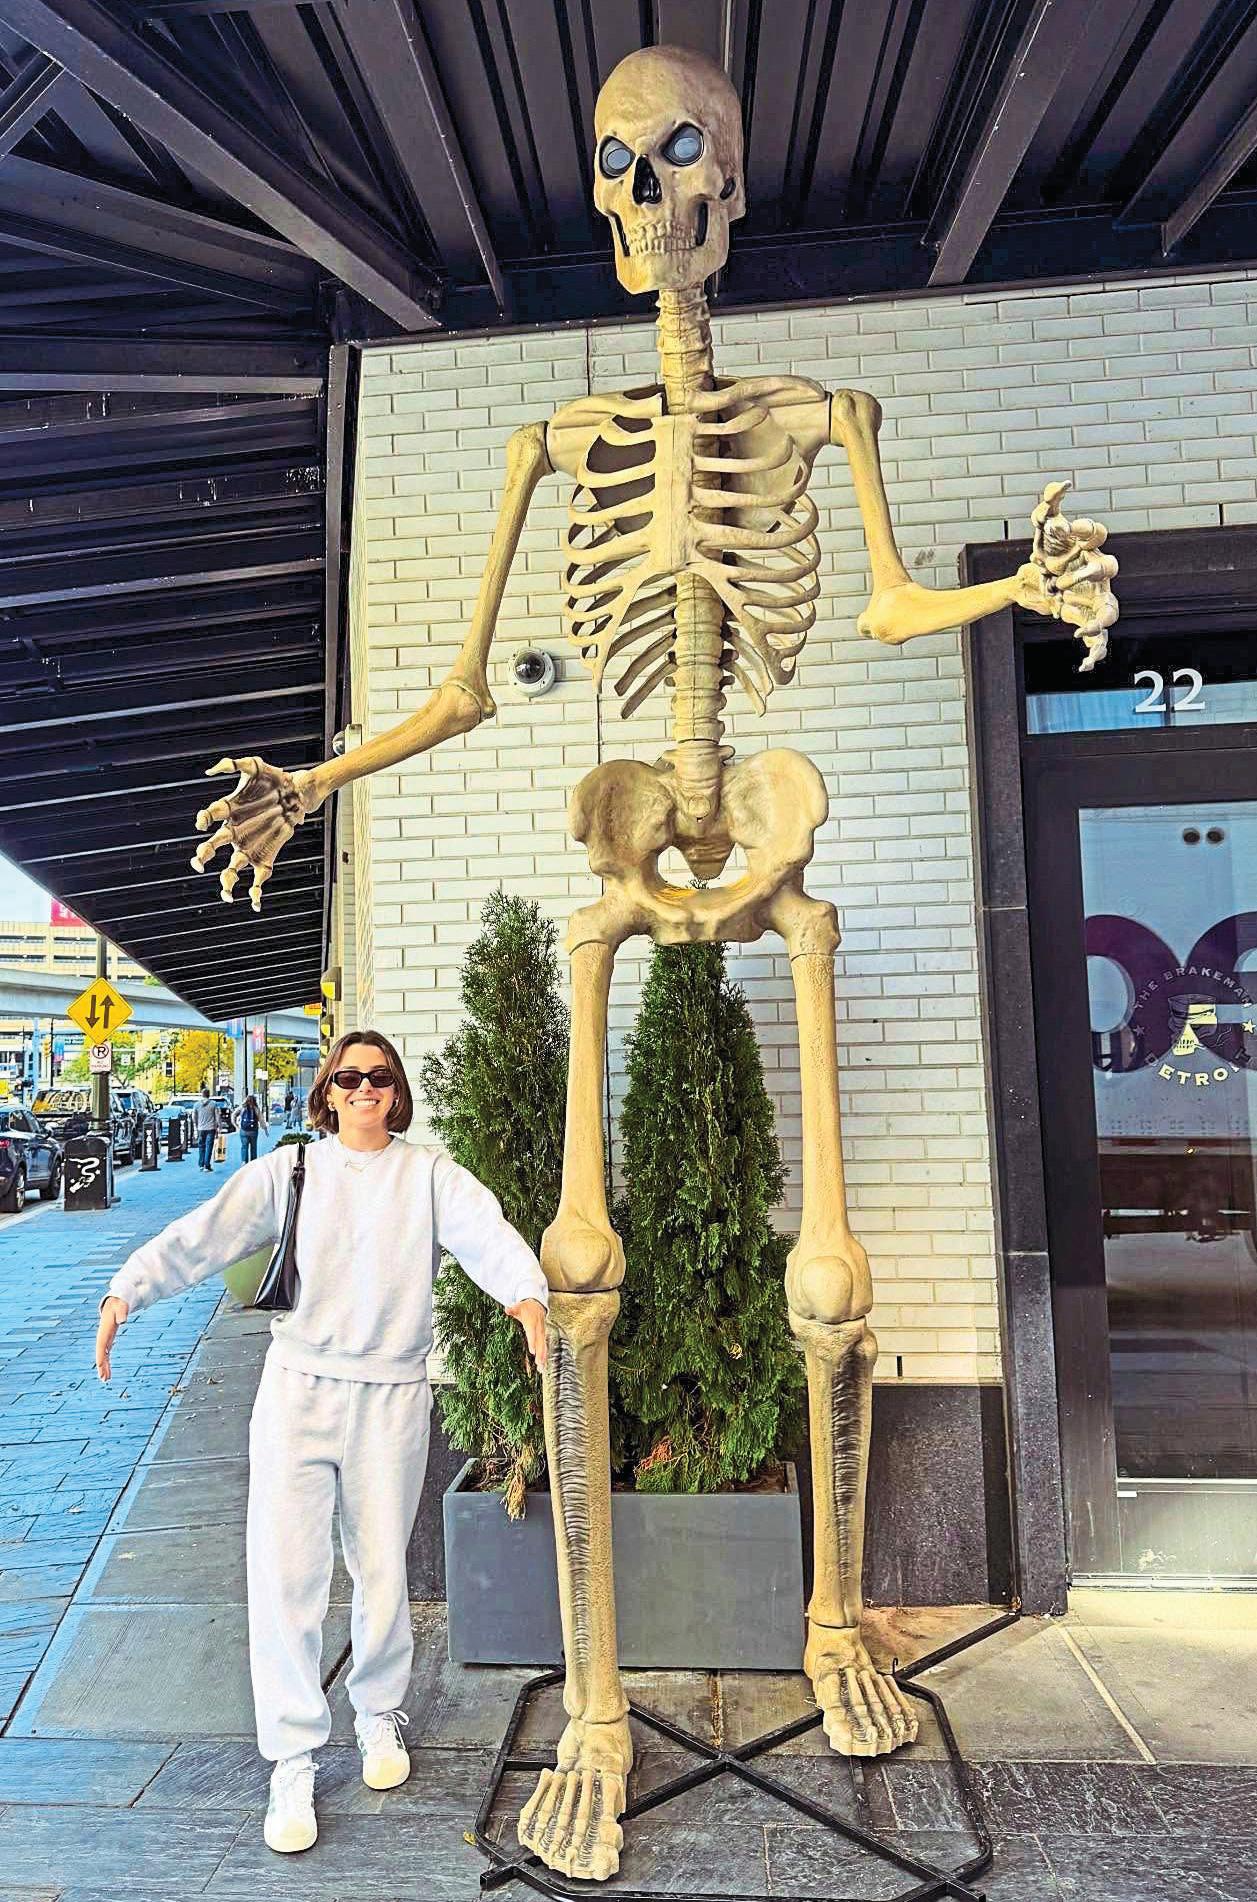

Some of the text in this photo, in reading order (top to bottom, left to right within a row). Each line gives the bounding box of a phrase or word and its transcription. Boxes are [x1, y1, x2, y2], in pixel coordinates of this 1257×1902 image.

[1133, 667, 1206, 713] 22
[1133, 966, 1252, 1009] THE BRAKEMAN
[1145, 1048, 1251, 1086] DETROIT
